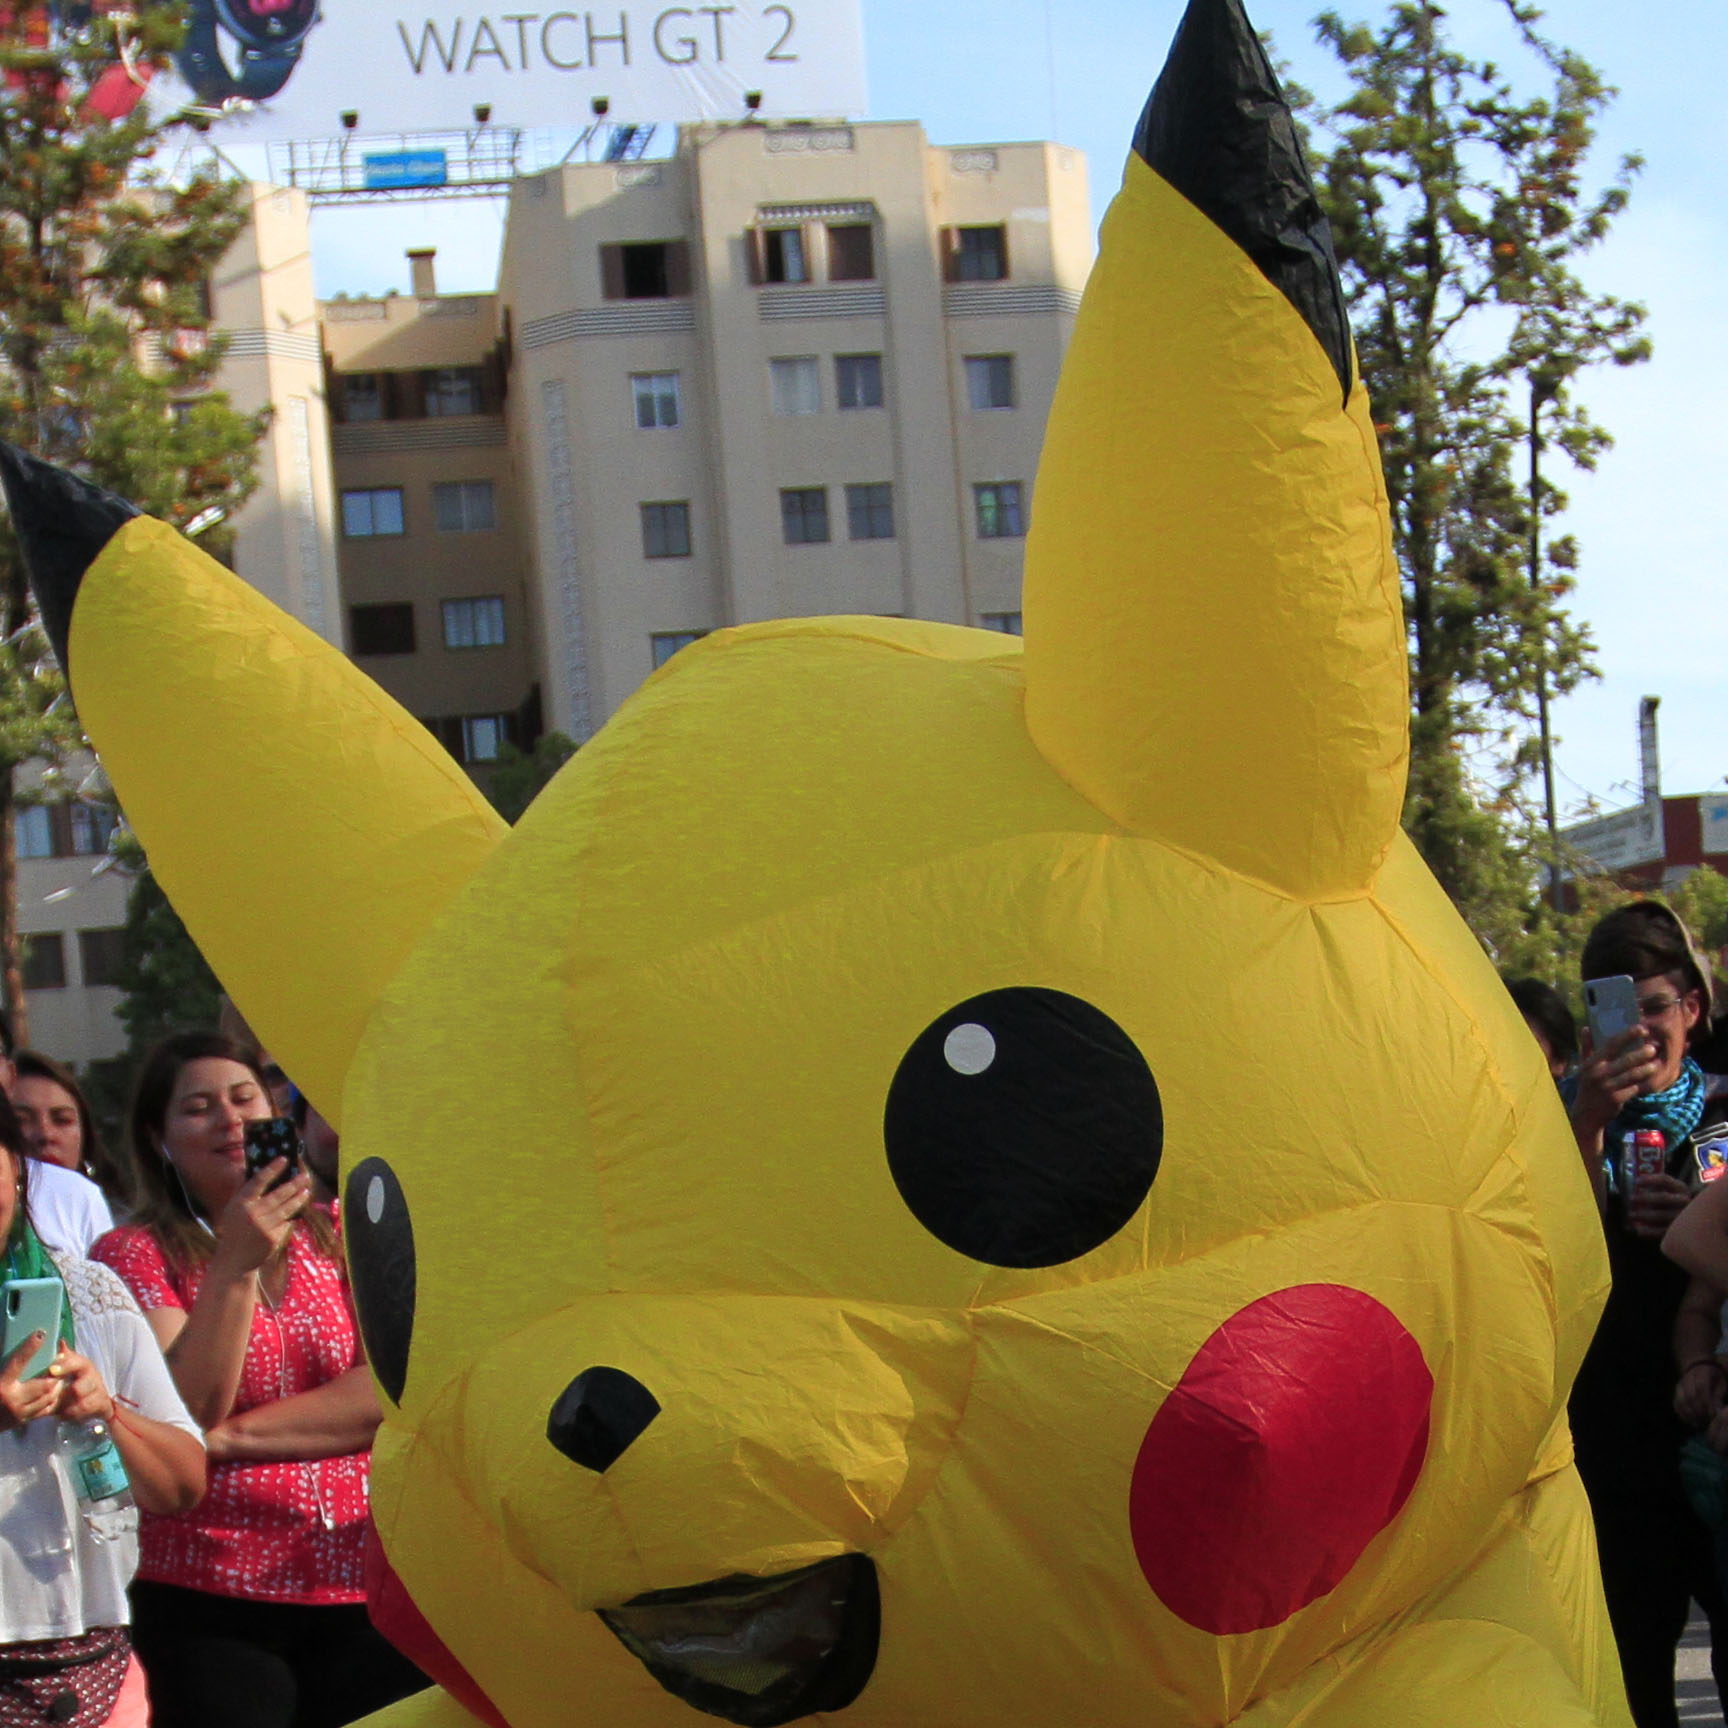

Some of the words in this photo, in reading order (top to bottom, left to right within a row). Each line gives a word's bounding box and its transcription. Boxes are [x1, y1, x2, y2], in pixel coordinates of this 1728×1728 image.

[398, 10, 630, 74] WATCH
[654, 6, 736, 66] GT
[764, 5, 799, 62] 2
